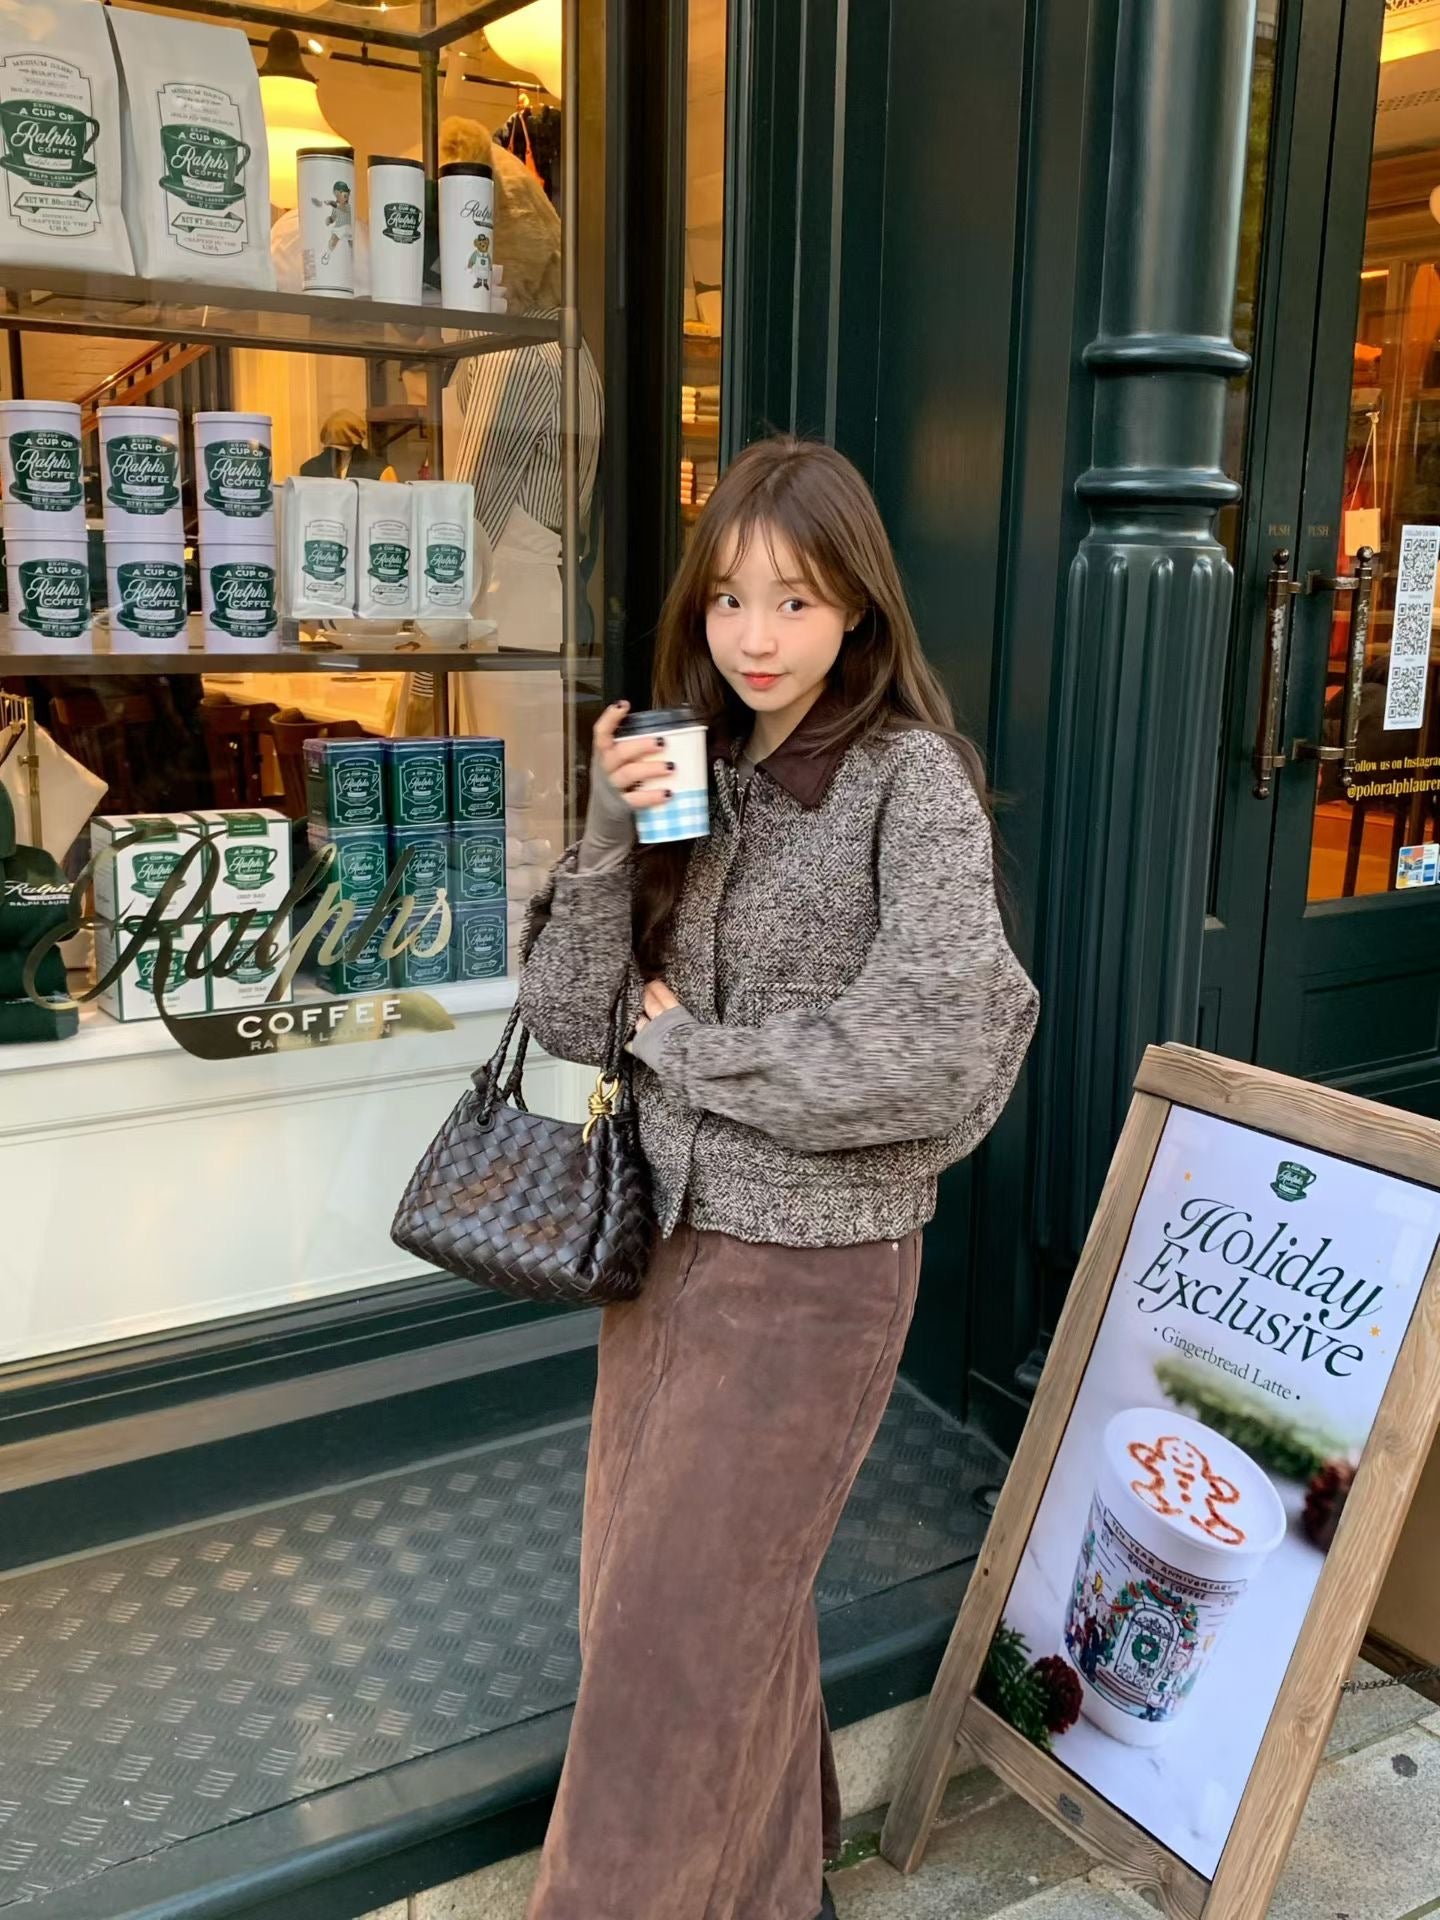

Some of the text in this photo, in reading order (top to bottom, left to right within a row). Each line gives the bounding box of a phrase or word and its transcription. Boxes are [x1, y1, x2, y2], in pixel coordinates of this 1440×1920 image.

[19, 107, 28, 115] A
[32, 107, 56, 117] CUP
[178, 131, 186, 139] A
[189, 132, 210, 142] CUP
[37, 146, 77, 156] COFFEE
[194, 169, 228, 179] COFFEE
[24, 438, 33, 446] A
[36, 438, 59, 446] CUP
[218, 447, 226, 455] A
[229, 447, 250, 455] CUP
[33, 470, 76, 480] COFFEE
[128, 475, 170, 484] COFFEE
[226, 478, 266, 487] COFFEE
[1268, 524, 1291, 537] PUSH
[1308, 525, 1329, 537] PUSH
[46, 566, 69, 574] CUP
[143, 568, 165, 576] CUP
[235, 569, 256, 577] CUP
[43, 598, 84, 606] COFFEE
[140, 599, 180, 607] COFFEE
[232, 600, 271, 608] COFFEE
[1380, 760, 1390, 770] us
[1391, 759, 1402, 769] on
[1404, 756, 1440, 769] Instagra
[237, 1000, 402, 1039] COFFEE
[1163, 1198, 1384, 1330] Holiday
[1133, 1239, 1364, 1377] Exclusive
[1162, 1326, 1292, 1400] Gingerbread Latte
[1129, 1540, 1155, 1567] YEAR
[1170, 1583, 1207, 1600] COFFEE
